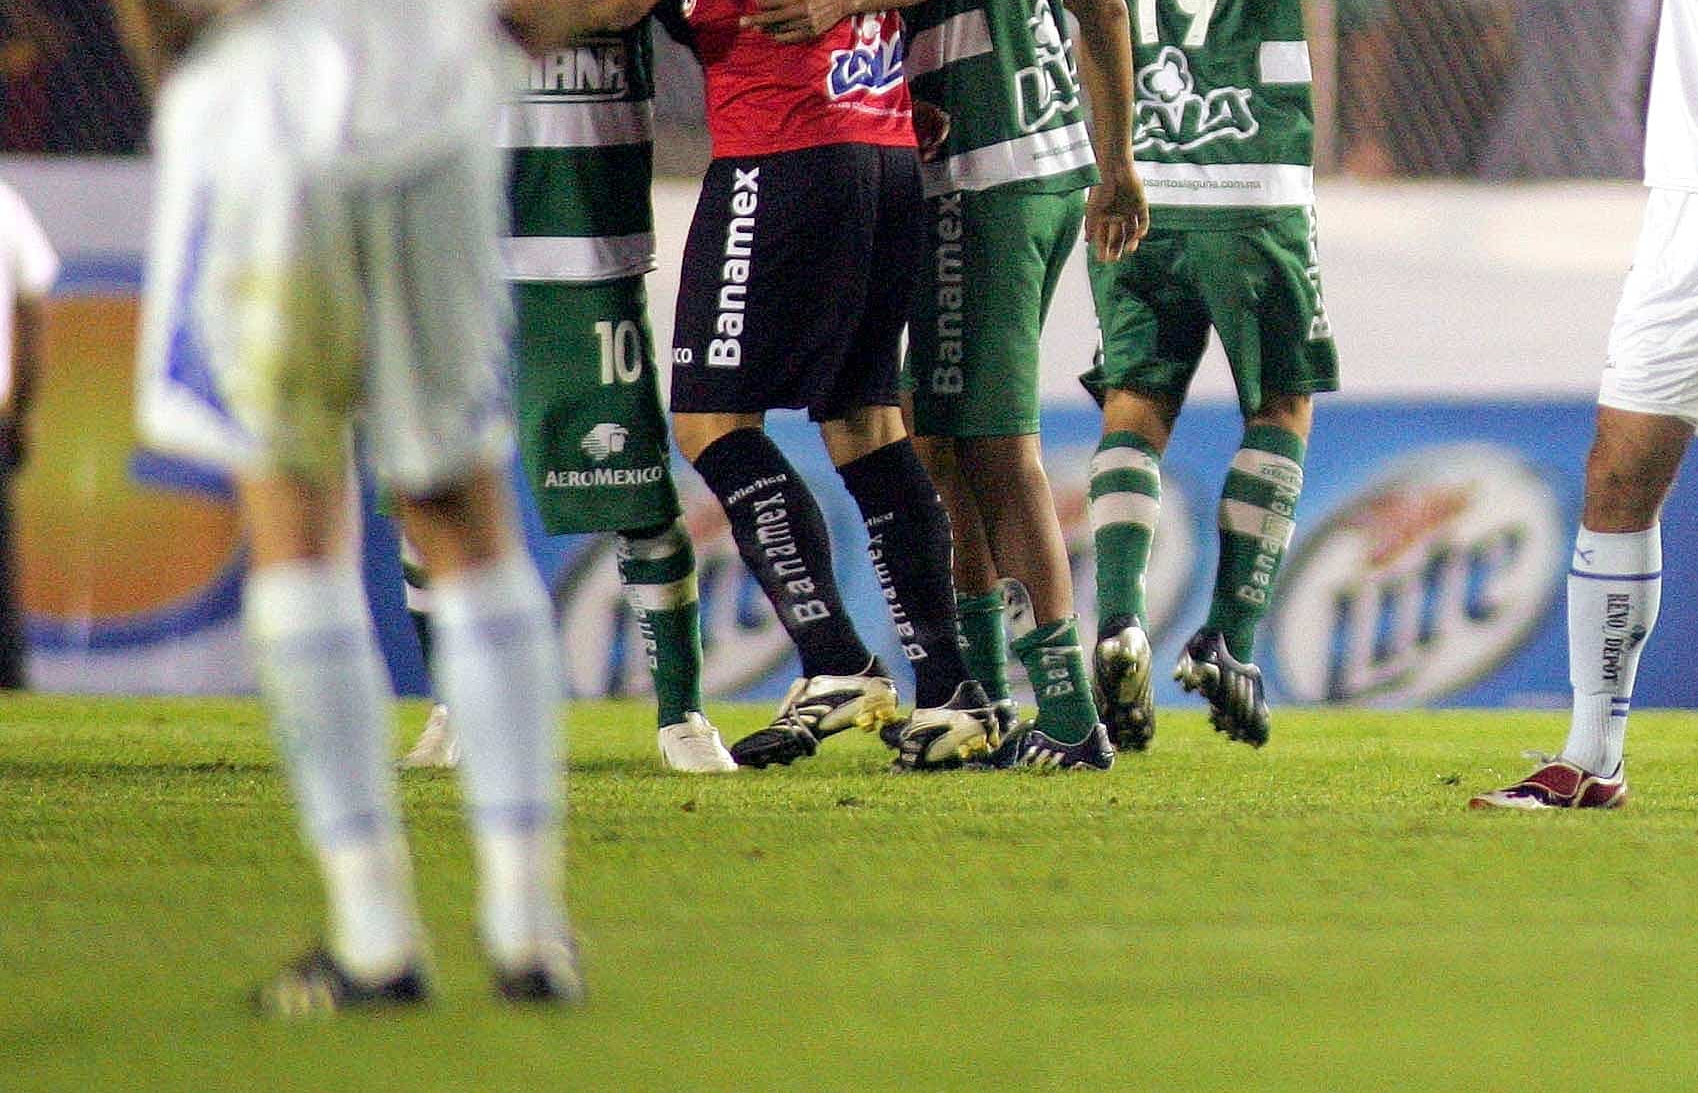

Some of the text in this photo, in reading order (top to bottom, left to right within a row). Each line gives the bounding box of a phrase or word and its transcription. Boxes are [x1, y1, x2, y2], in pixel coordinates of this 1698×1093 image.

[708, 167, 760, 367] Banamex
[931, 193, 964, 395] Banamex
[595, 320, 643, 385] 10
[545, 465, 664, 488] AEROMEXICO
[753, 491, 831, 622] Banamex
